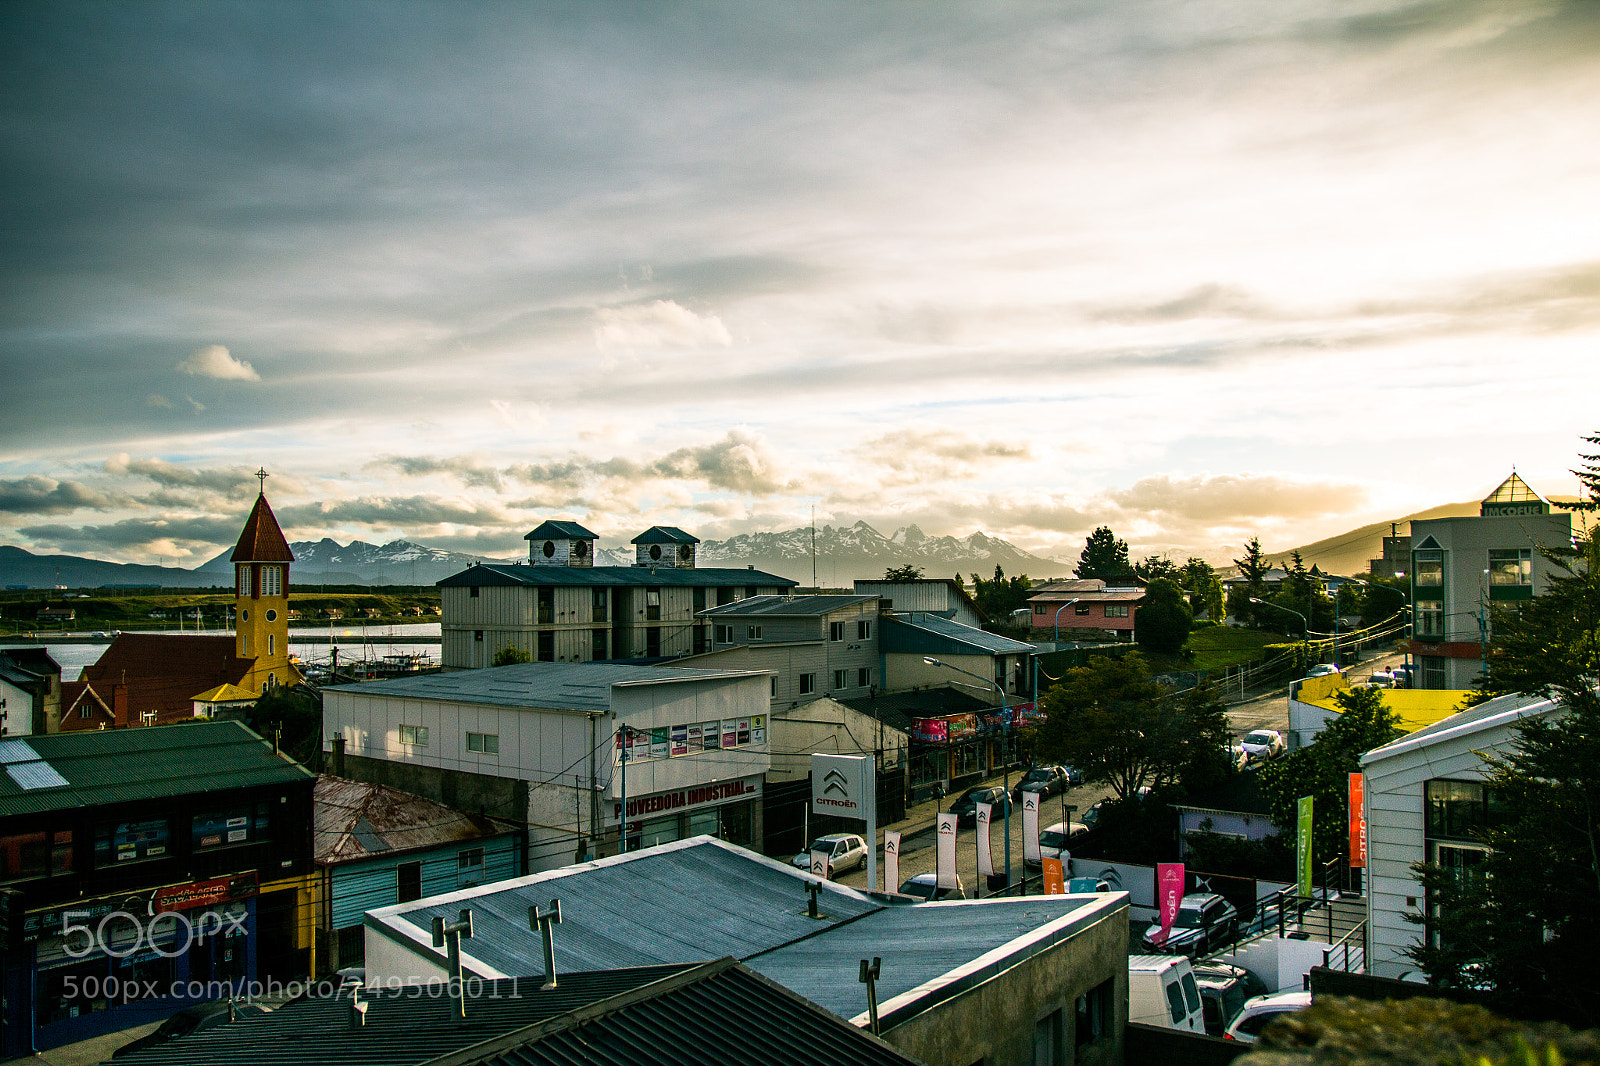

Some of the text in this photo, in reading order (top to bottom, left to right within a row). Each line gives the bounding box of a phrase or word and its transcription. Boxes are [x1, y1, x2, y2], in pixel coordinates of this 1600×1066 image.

[739, 721, 748, 729] 3M
[614, 791, 687, 819] PROVEEDORA
[687, 780, 746, 805] INDUSTRIAL
